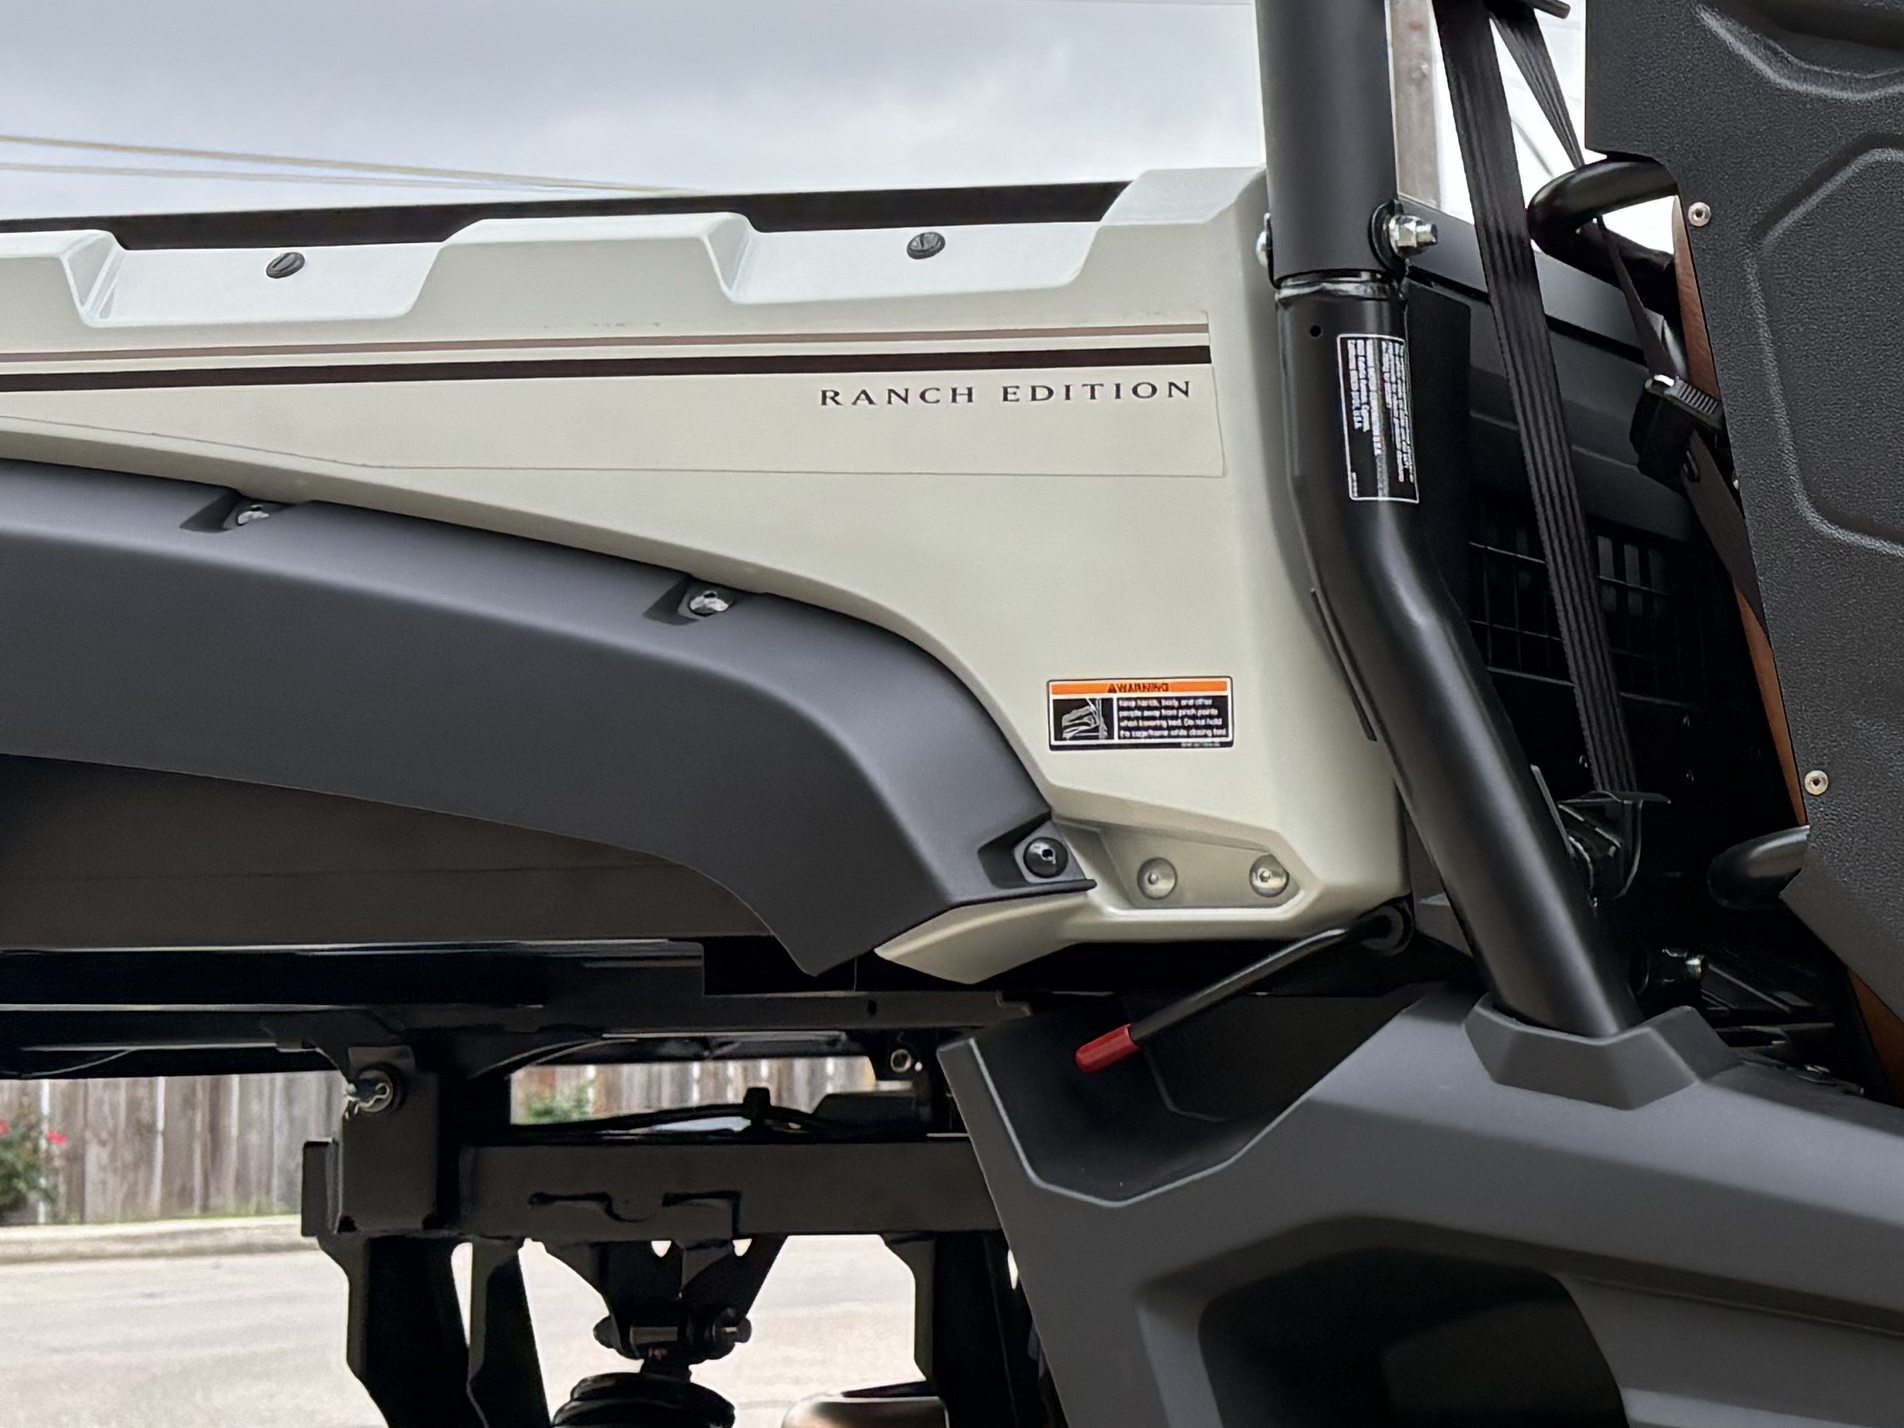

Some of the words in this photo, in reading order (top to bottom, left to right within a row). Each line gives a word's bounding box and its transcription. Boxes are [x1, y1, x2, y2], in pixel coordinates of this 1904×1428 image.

[819, 386, 974, 406] RANCH
[1001, 380, 1192, 403] EDITION
[1116, 682, 1169, 693] WARNING
